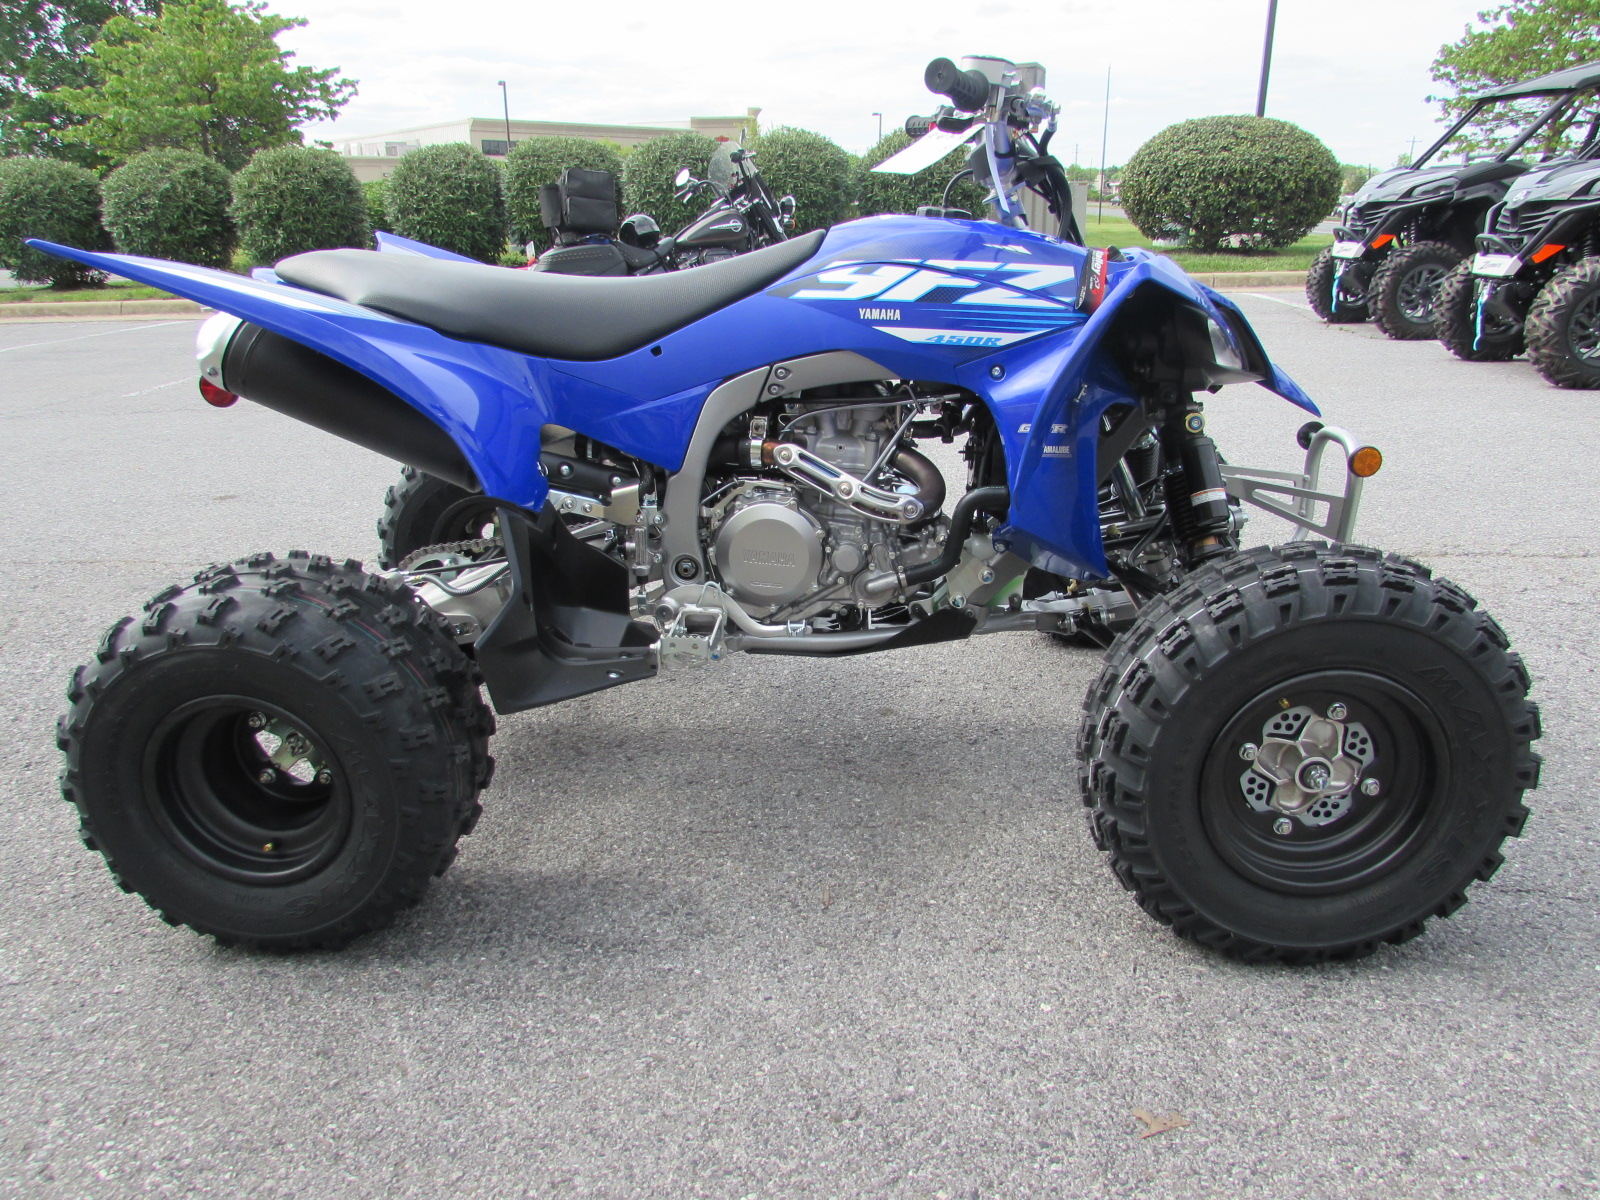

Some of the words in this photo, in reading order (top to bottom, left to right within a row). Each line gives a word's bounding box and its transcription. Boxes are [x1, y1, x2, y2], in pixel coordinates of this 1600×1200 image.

[788, 258, 1076, 310] YFZ
[859, 308, 901, 321] YAMAHA
[924, 334, 1003, 347] 450R
[1043, 445, 1070, 454] AMALUBE
[742, 549, 796, 568] YAMAHA
